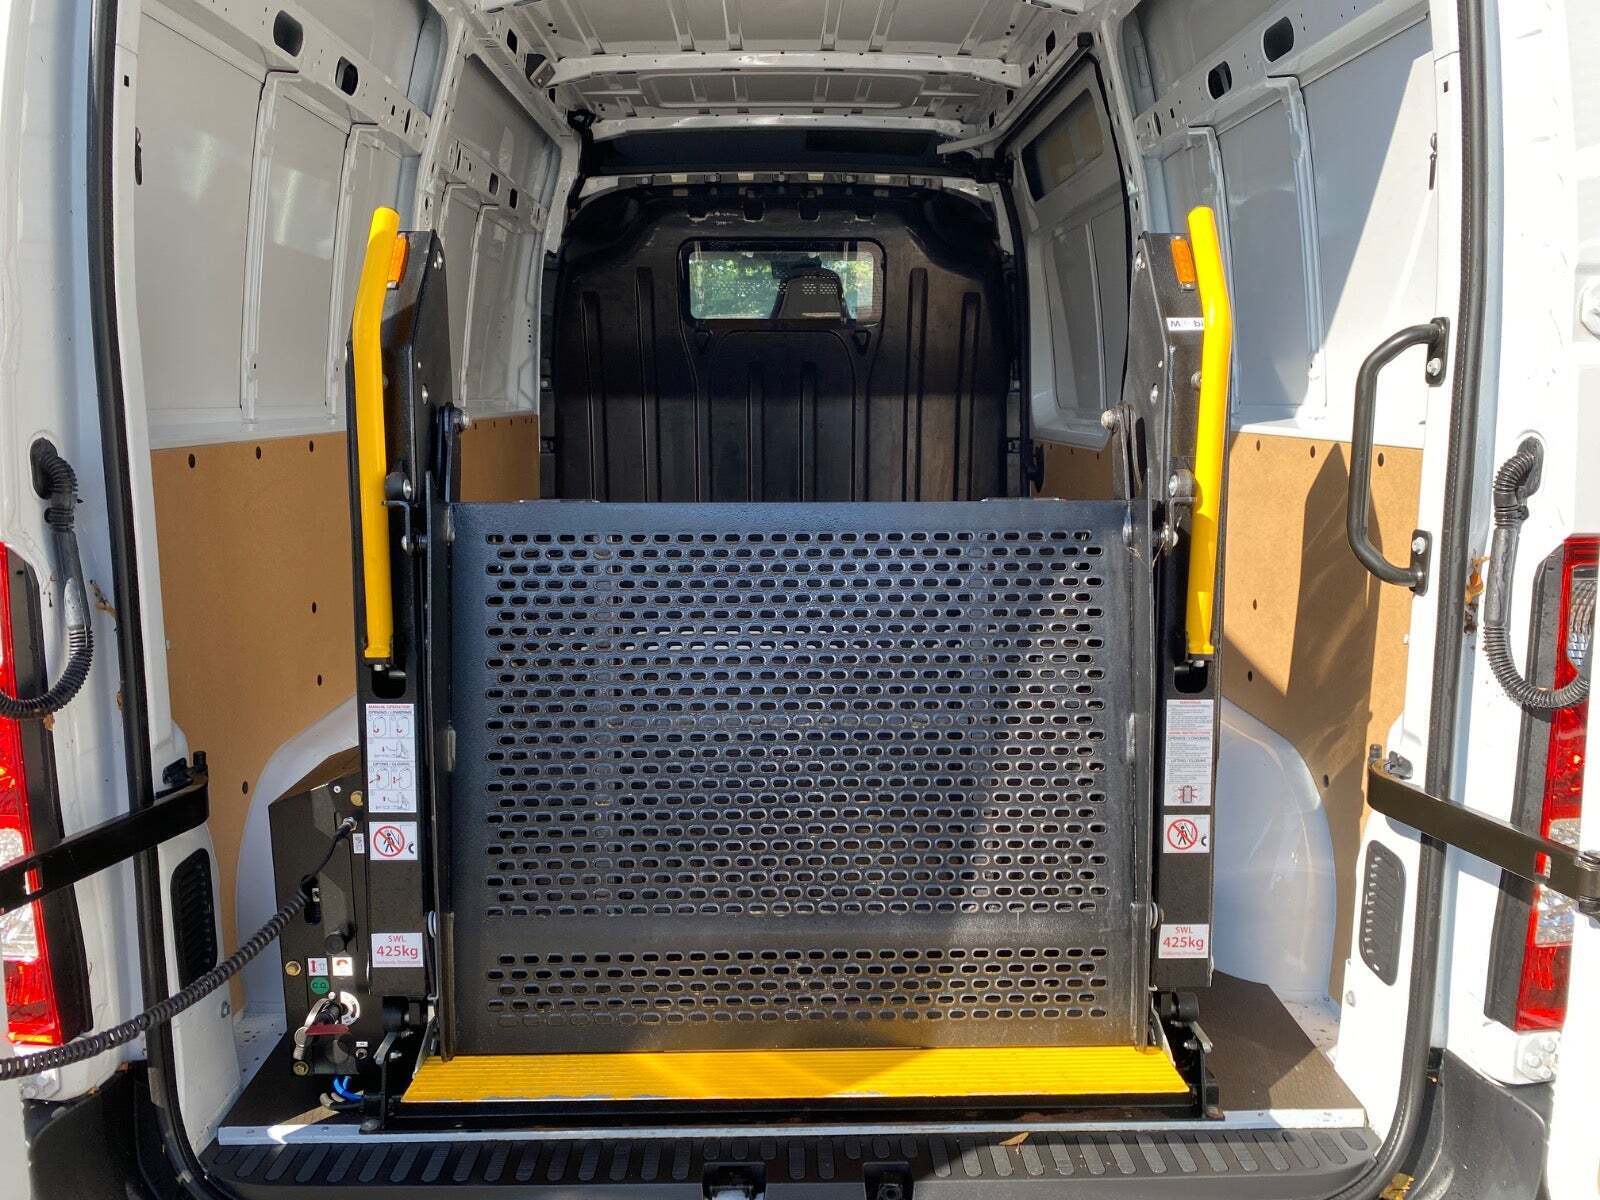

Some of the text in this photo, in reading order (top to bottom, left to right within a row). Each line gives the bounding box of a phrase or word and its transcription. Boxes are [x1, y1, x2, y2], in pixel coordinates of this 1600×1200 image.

[1175, 926, 1193, 935] SWL
[387, 935, 406, 943] SWL
[1162, 936, 1204, 951] 425kg
[376, 945, 419, 960] 425kg
